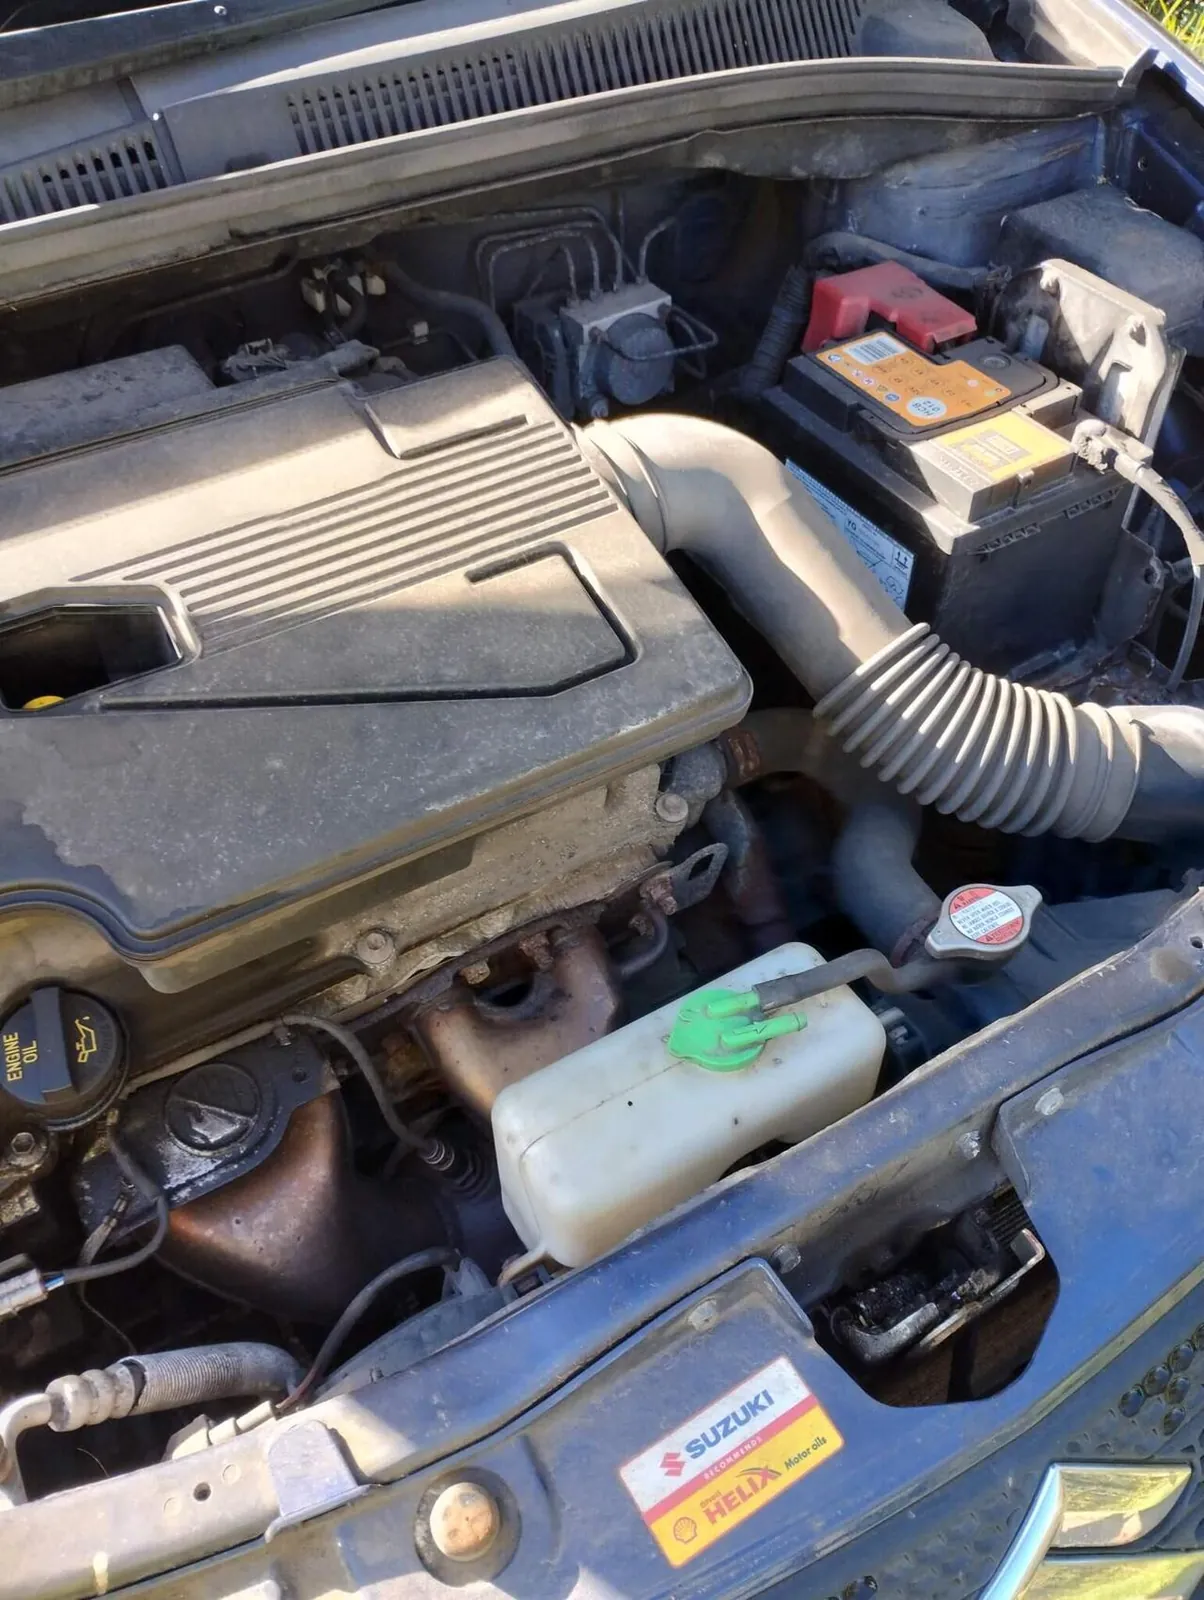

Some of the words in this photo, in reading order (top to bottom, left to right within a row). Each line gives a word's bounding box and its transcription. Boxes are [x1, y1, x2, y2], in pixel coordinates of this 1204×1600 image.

[3, 1032, 23, 1082] ENGINE
[21, 1040, 39, 1064] OIL
[685, 1389, 775, 1460] SUZUKI
[703, 1436, 763, 1480] RECOMMENDS
[784, 1447, 811, 1470] Motor
[811, 1436, 828, 1452] oils
[702, 1466, 782, 1526] HELIX
